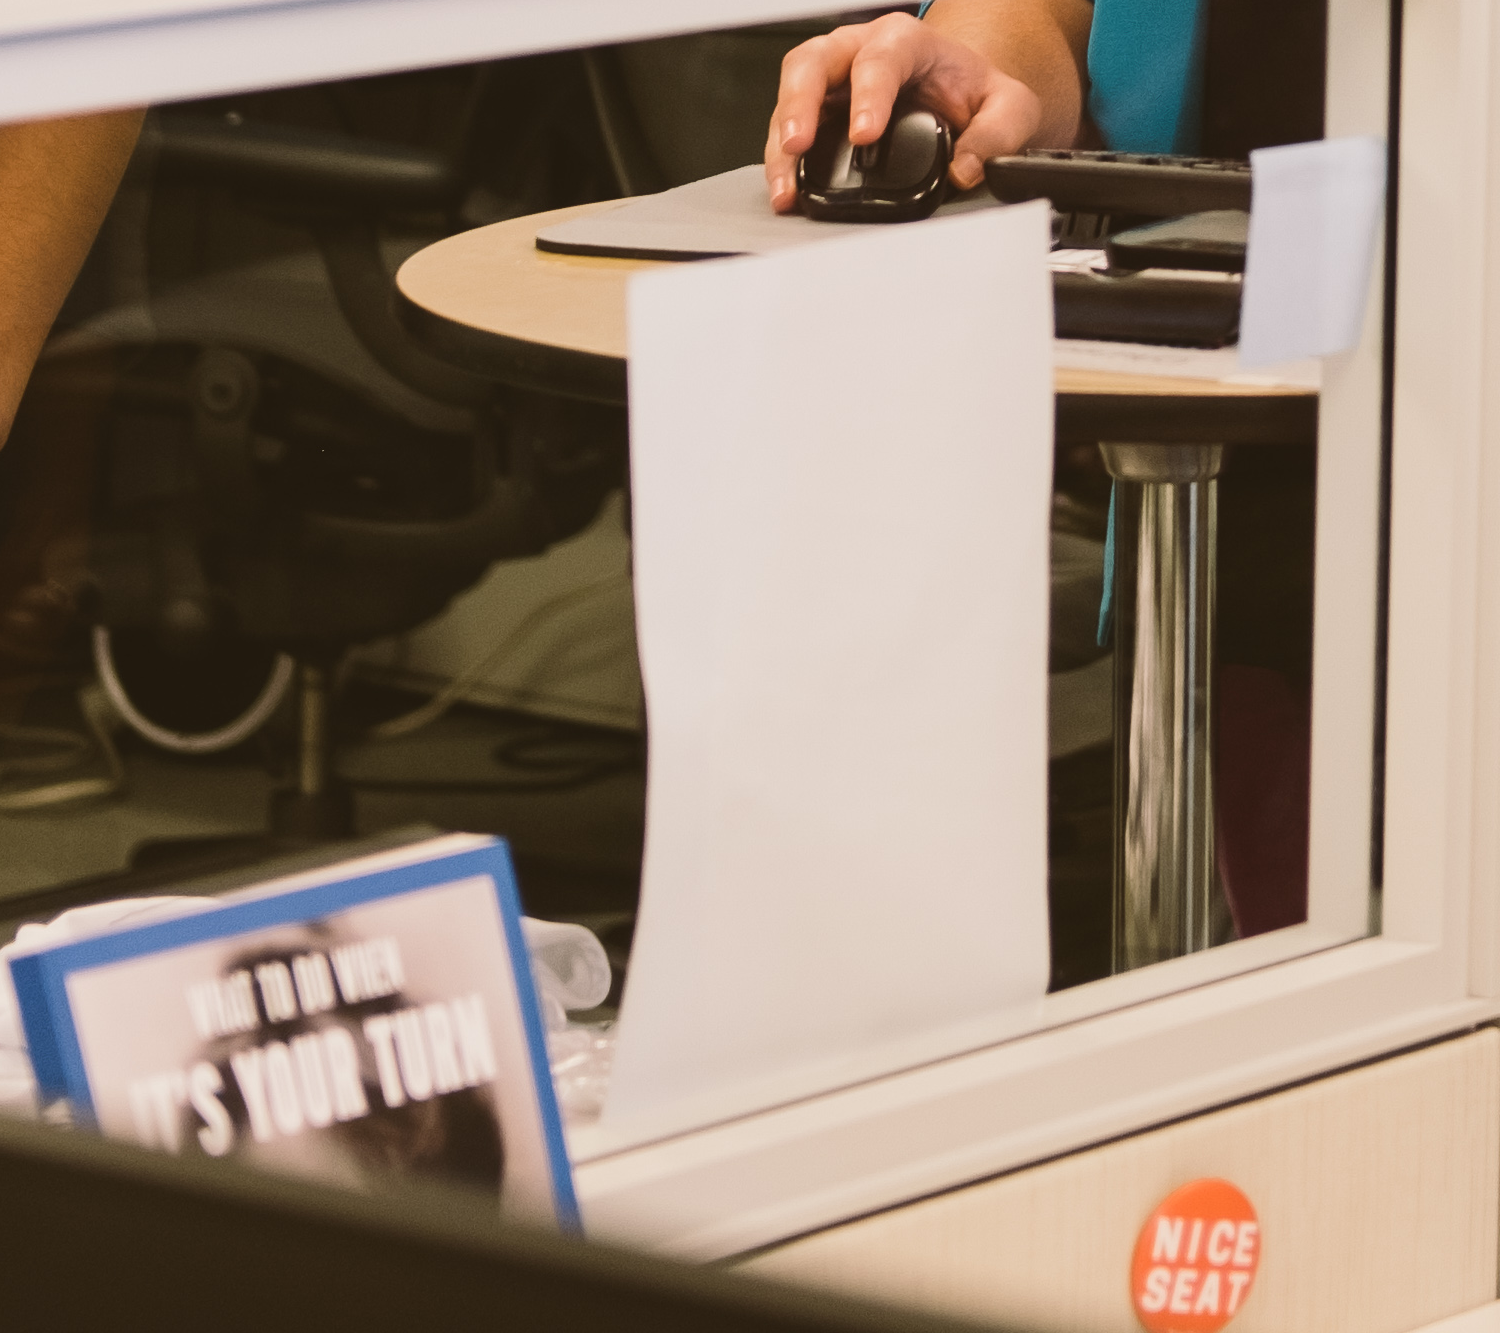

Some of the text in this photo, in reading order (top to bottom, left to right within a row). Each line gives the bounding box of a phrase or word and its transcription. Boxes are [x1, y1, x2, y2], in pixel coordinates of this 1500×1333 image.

[185, 935, 407, 1041] WHAT TO DO WHEN
[230, 1023, 371, 1145] YOUR
[363, 992, 499, 1110] TURN
[1151, 1214, 1258, 1268] NICE
[1140, 1266, 1251, 1317] SEAT
